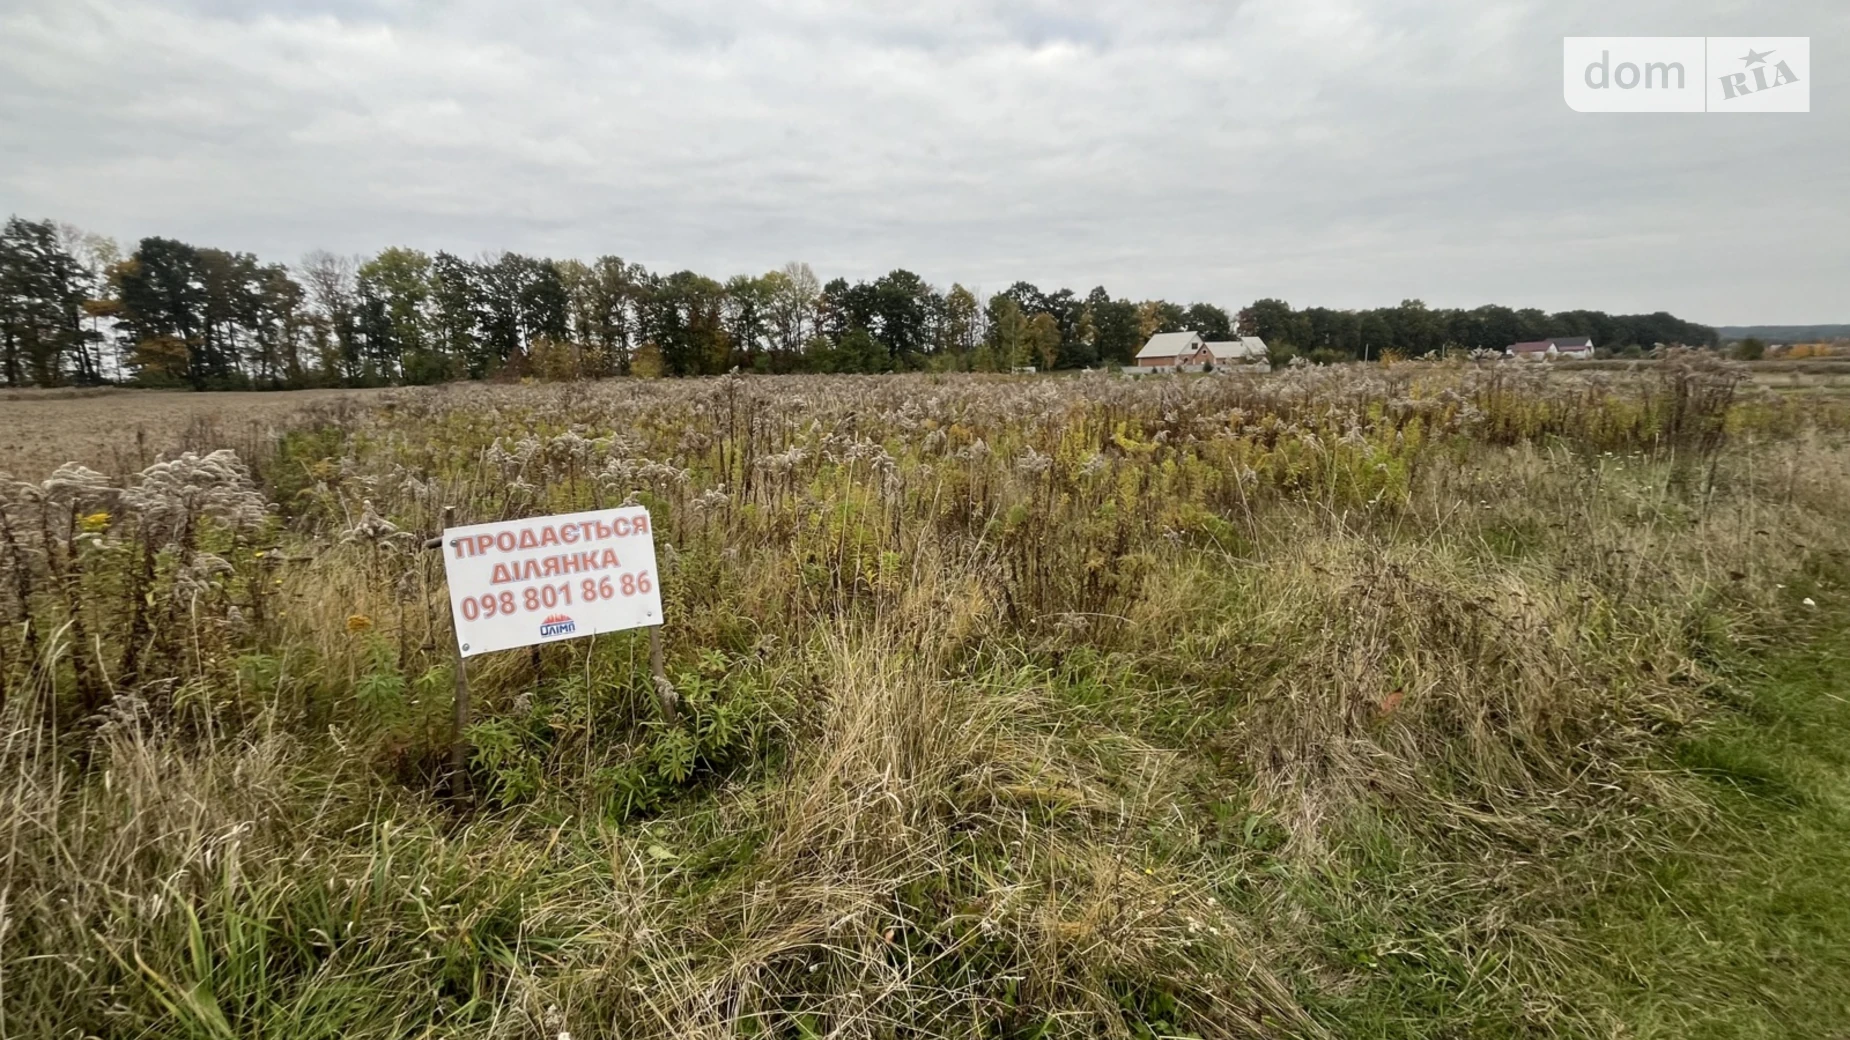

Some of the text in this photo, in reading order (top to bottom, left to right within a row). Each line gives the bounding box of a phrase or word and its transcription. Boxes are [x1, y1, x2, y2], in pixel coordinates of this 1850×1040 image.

[455, 514, 649, 559] ПРОДАЄТЬСЯ
[490, 548, 621, 585] ДІЛЯНКА
[461, 570, 652, 622] 098 801 86 86
